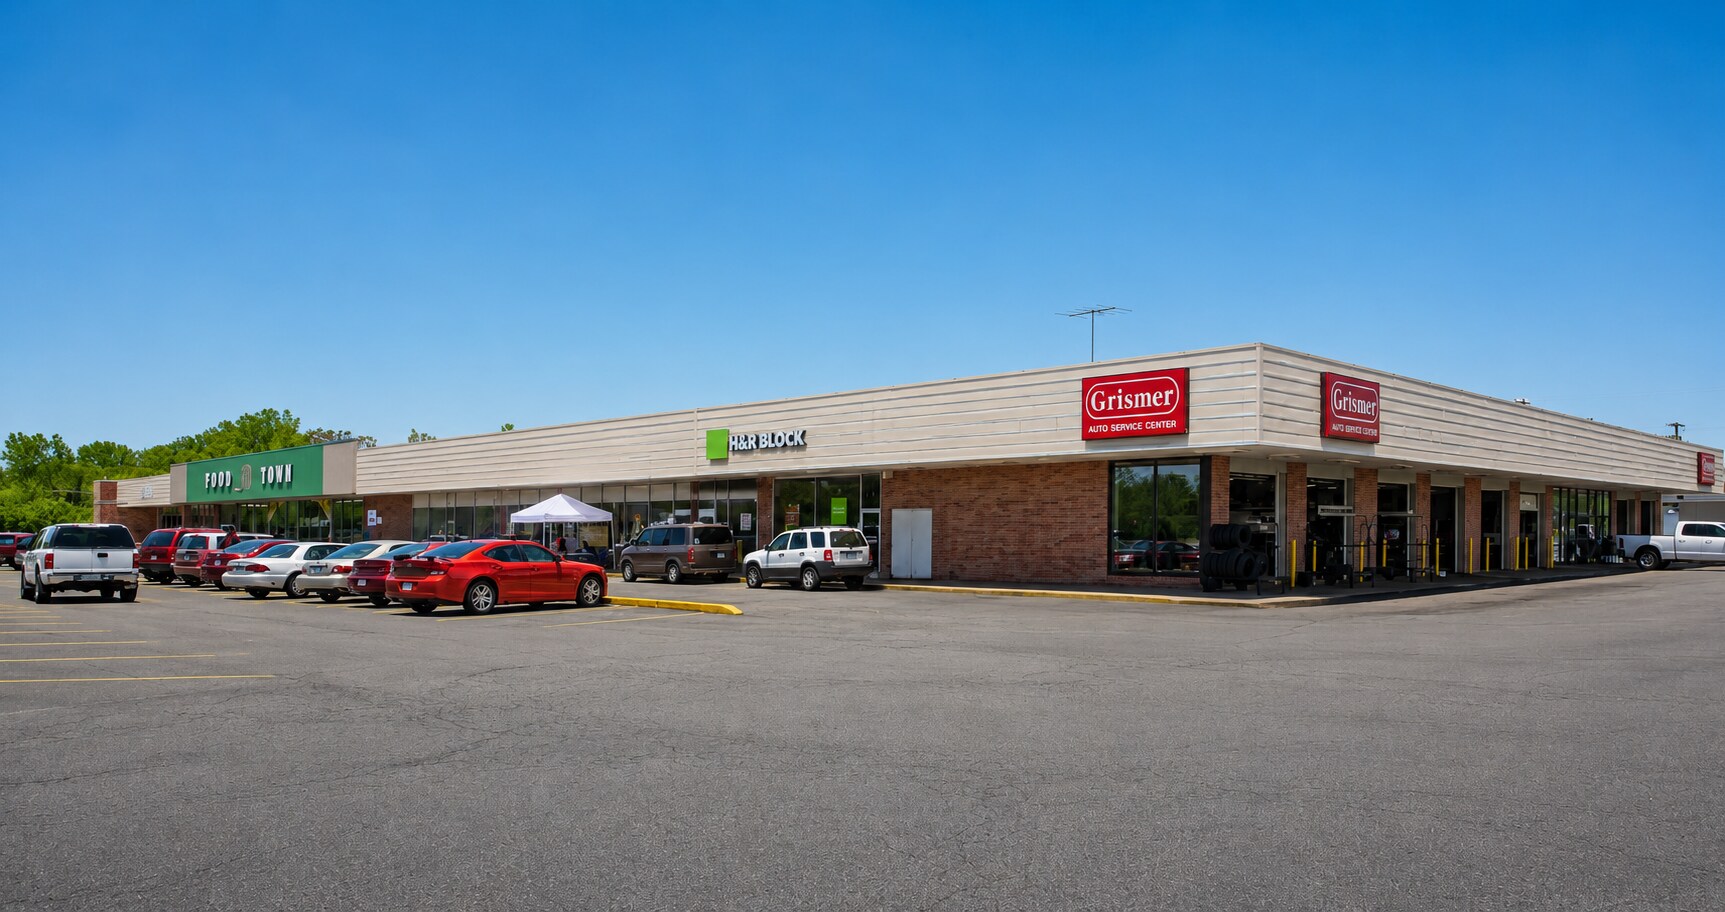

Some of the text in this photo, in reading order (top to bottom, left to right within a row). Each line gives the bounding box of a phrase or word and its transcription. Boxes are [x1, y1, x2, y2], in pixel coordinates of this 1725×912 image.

[1091, 389, 1174, 412] Grismer
[1333, 388, 1377, 416] Grismer
[1088, 420, 1177, 433] AUTO SERVICE CENTER
[729, 429, 805, 451] H&R BLOCK
[205, 464, 292, 489] FOOD TOWN
